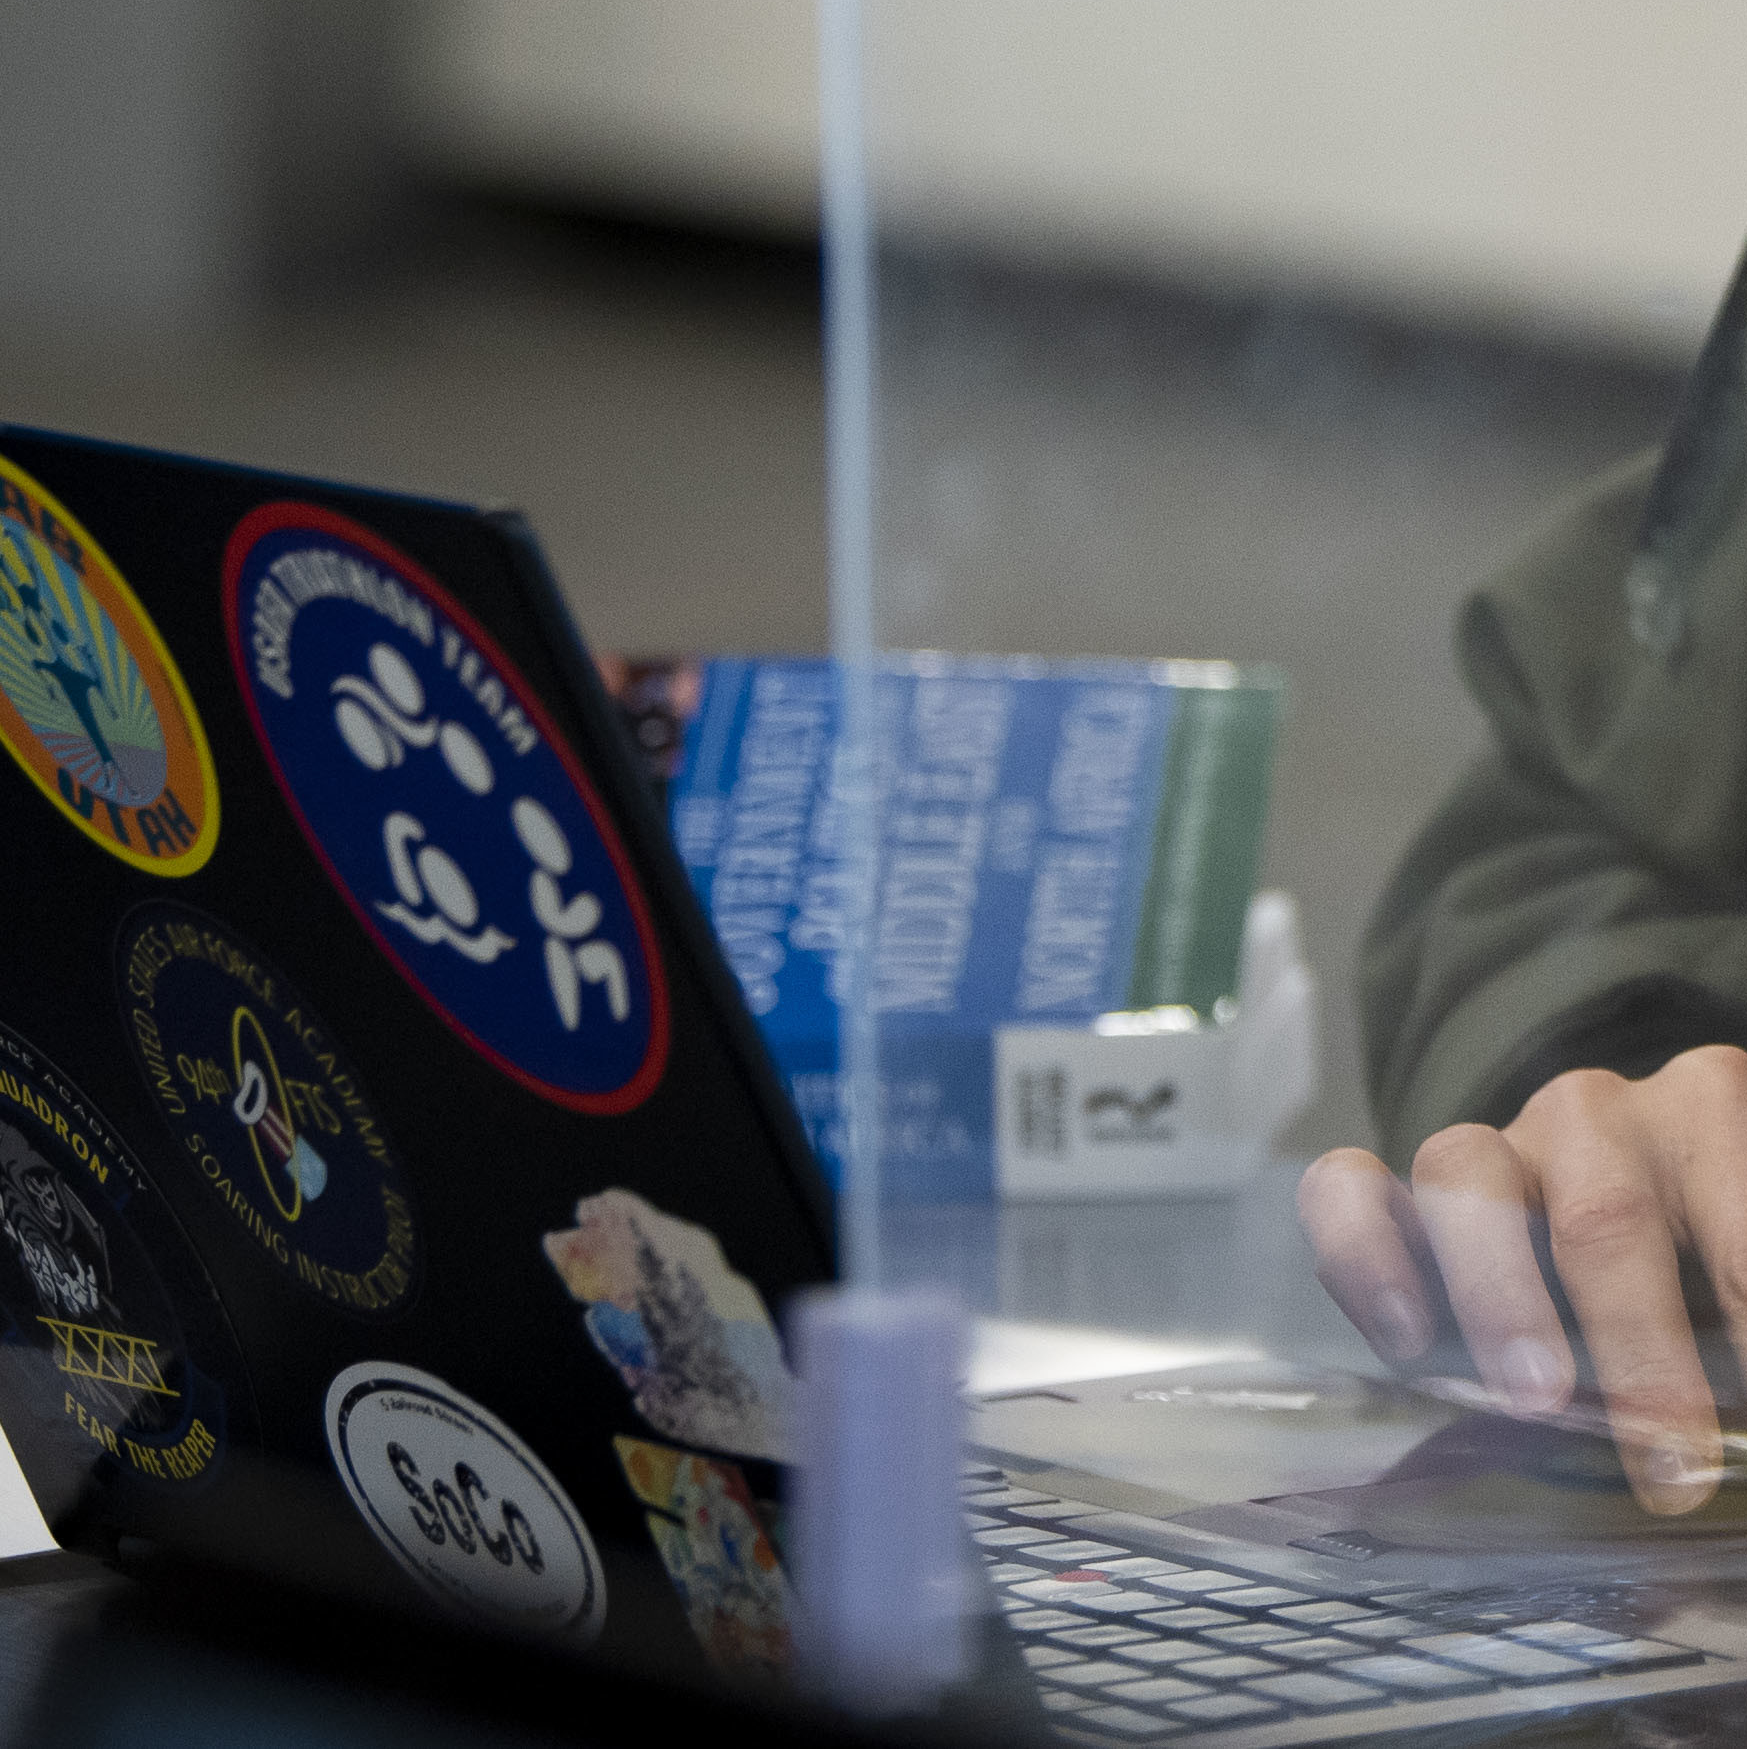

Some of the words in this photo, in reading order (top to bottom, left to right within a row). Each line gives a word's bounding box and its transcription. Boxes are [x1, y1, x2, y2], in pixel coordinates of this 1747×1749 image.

[441, 624, 539, 756] TEAM
[57, 766, 198, 858] UTAH
[128, 923, 172, 1010] STATES
[133, 1007, 187, 1115] UNITED
[283, 1006, 393, 1169] ACADEMY
[284, 1076, 343, 1137] FTS
[184, 1133, 289, 1265] SOARING
[64, 1390, 122, 1459] FEAR
[123, 1436, 168, 1480] THE
[160, 1417, 217, 1480] REAPER
[386, 1441, 546, 1576] SoCo
